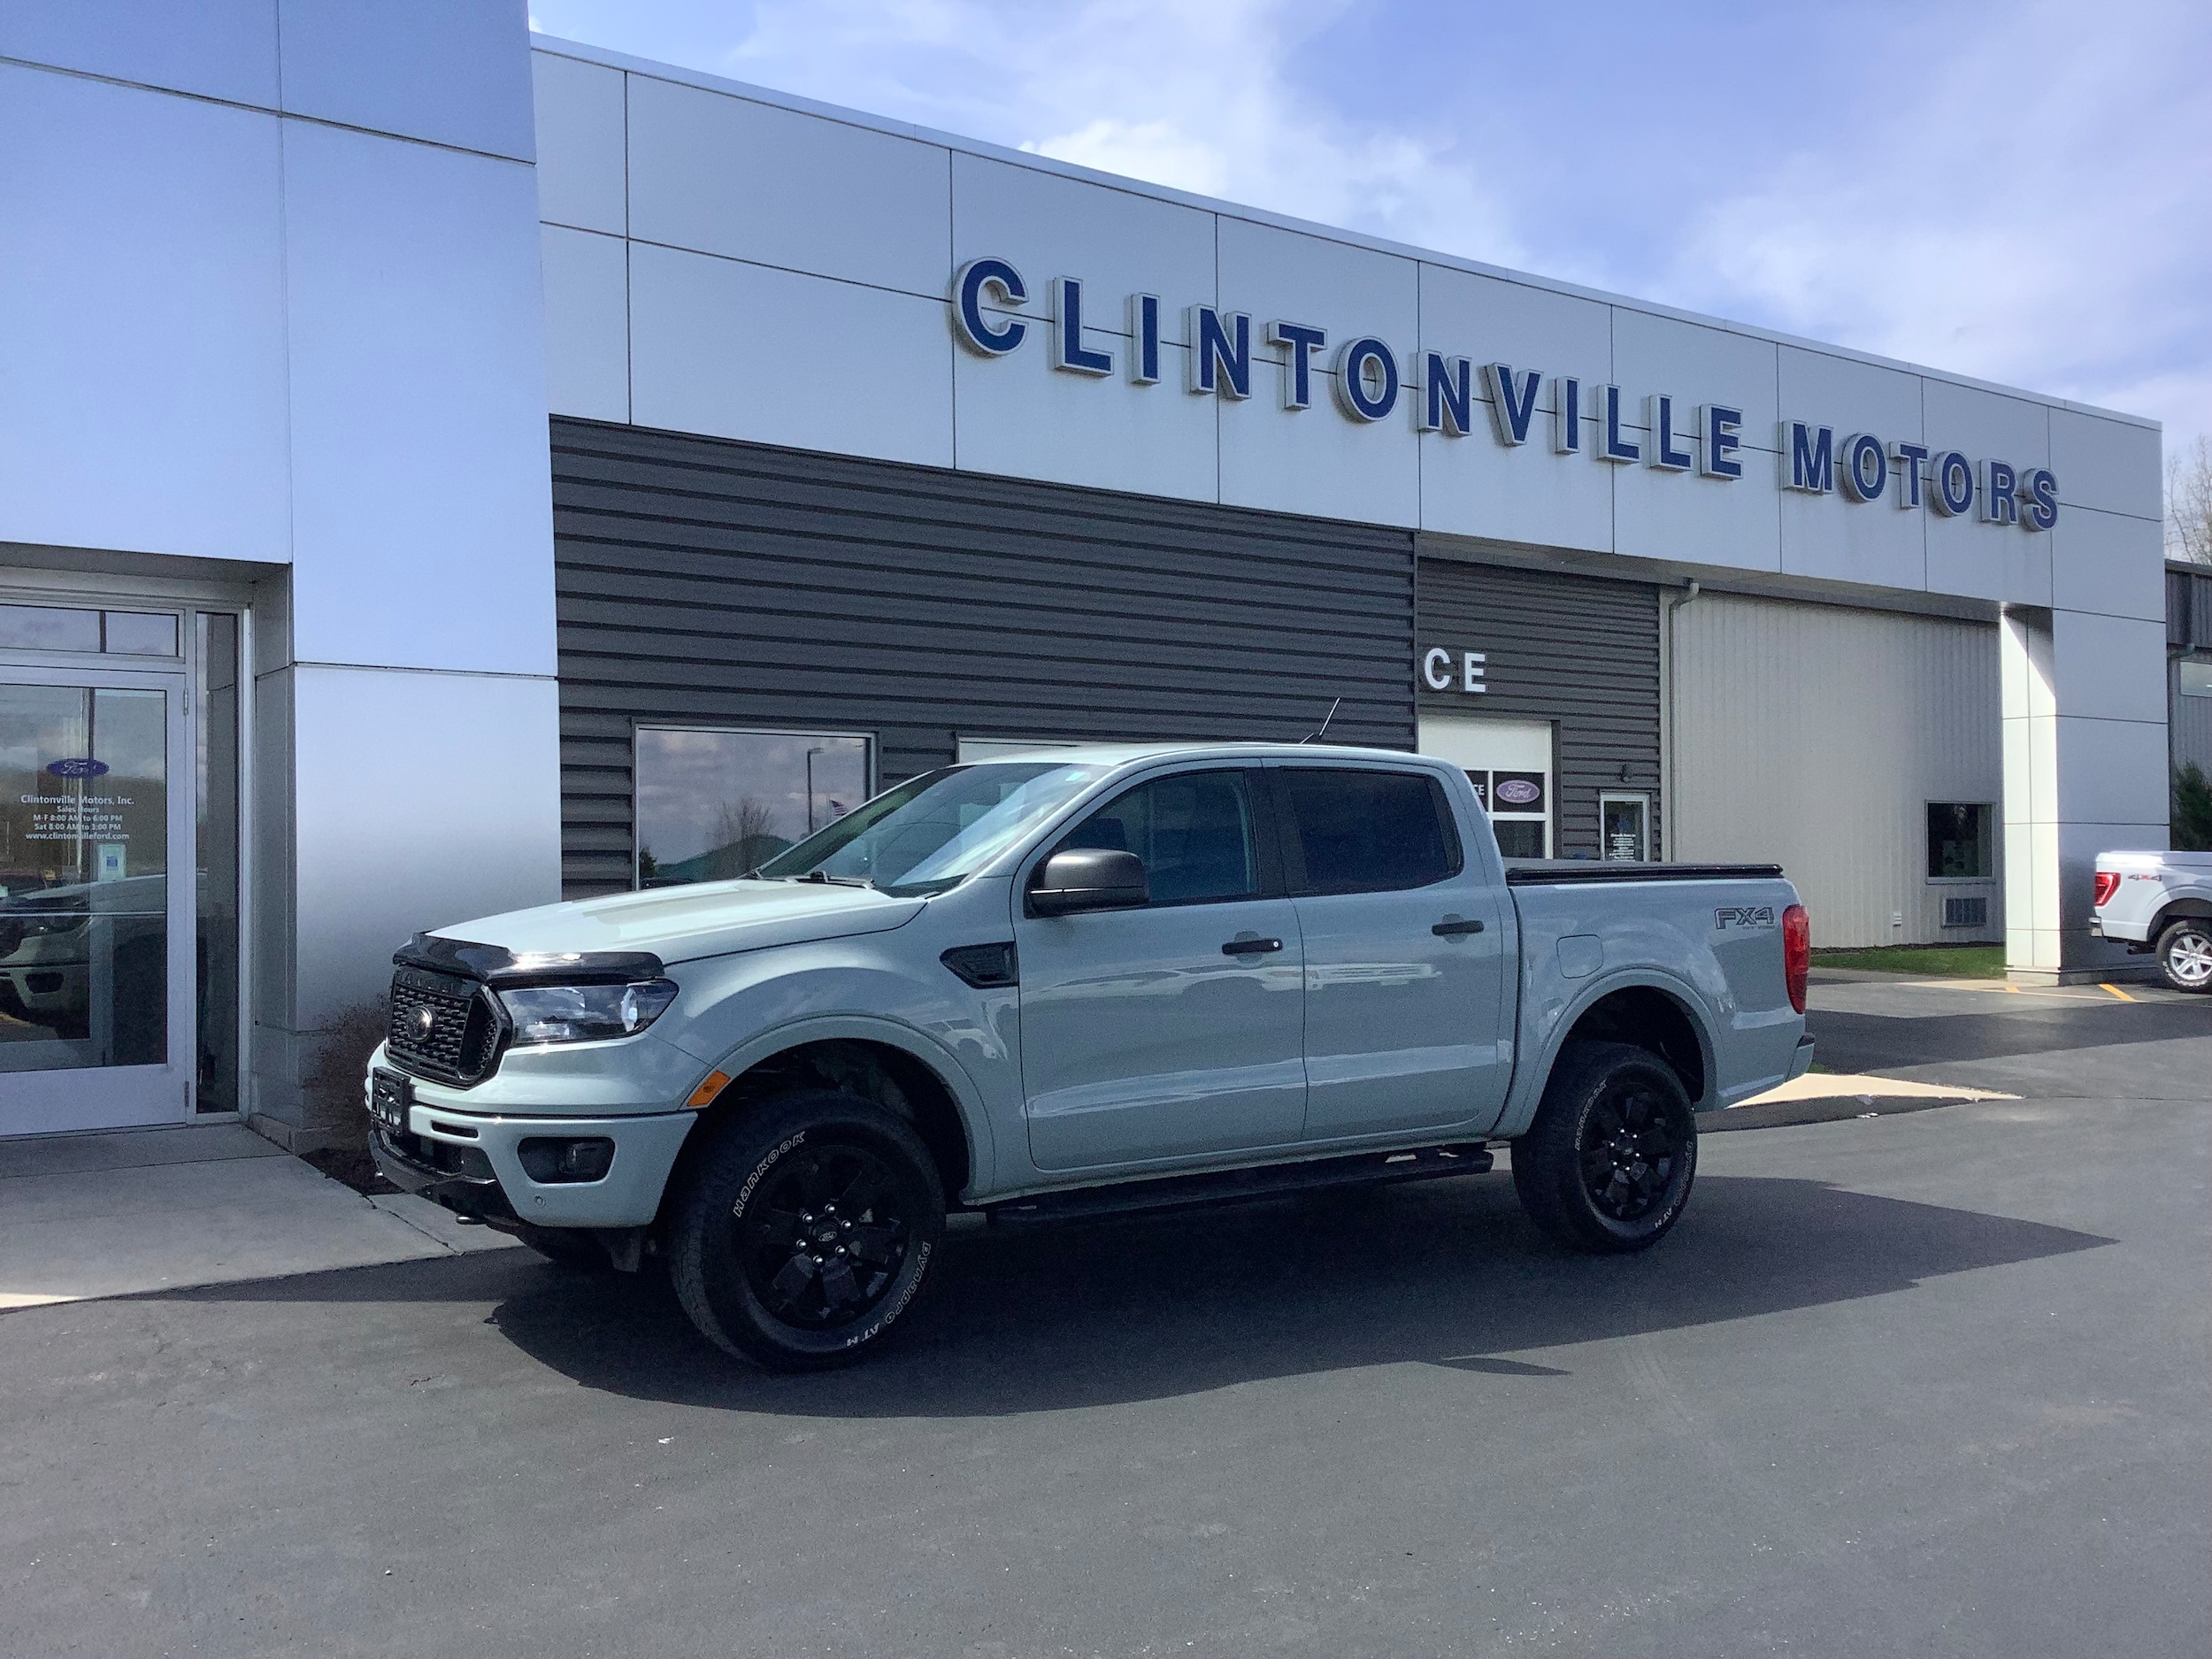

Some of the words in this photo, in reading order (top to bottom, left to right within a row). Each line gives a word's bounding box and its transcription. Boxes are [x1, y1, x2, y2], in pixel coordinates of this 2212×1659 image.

[952, 256, 1742, 480] CLINTONVILLE
[1782, 419, 2060, 532] MOTORS
[1425, 647, 1486, 693] CE
[20, 795, 76, 804] Clintonville
[78, 795, 115, 805] Motors,
[117, 795, 134, 805] Inc.
[1714, 906, 1775, 930] FX4
